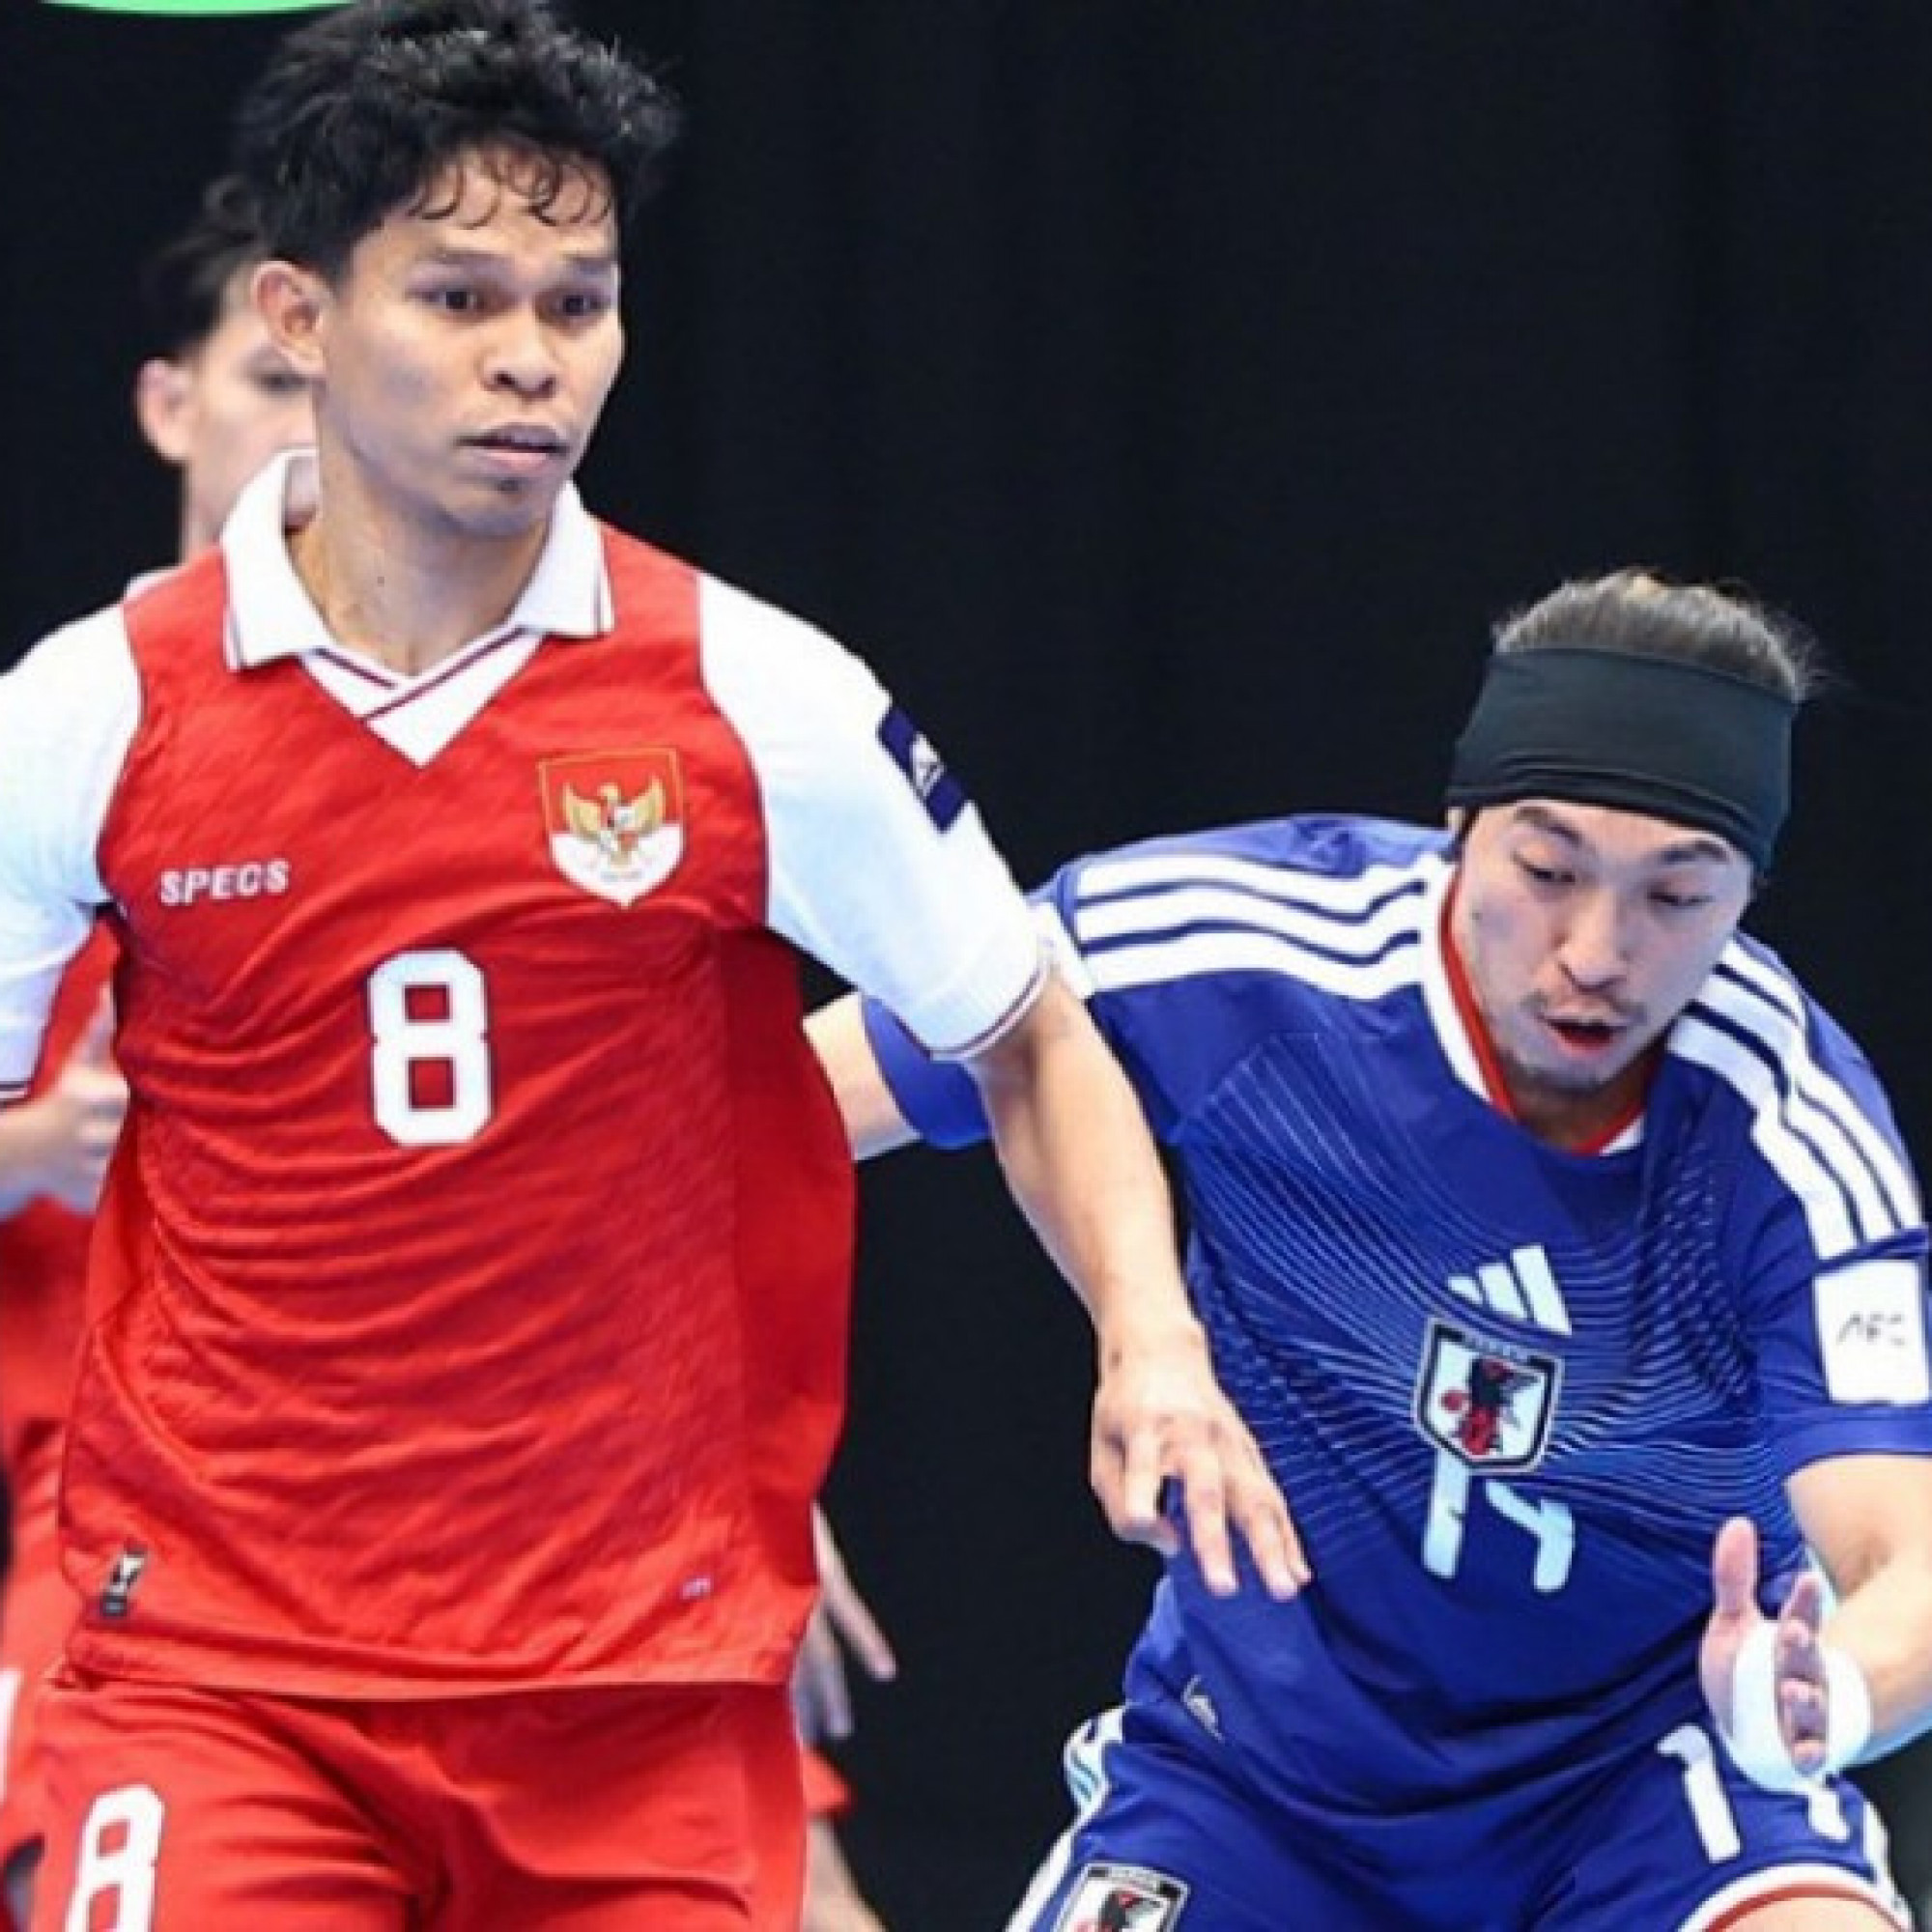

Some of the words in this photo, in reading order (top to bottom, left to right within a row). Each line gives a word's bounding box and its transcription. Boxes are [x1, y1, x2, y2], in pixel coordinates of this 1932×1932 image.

[159, 858, 290, 905] SPECS
[367, 949, 493, 1146] 8
[66, 1784, 165, 1932] 8
